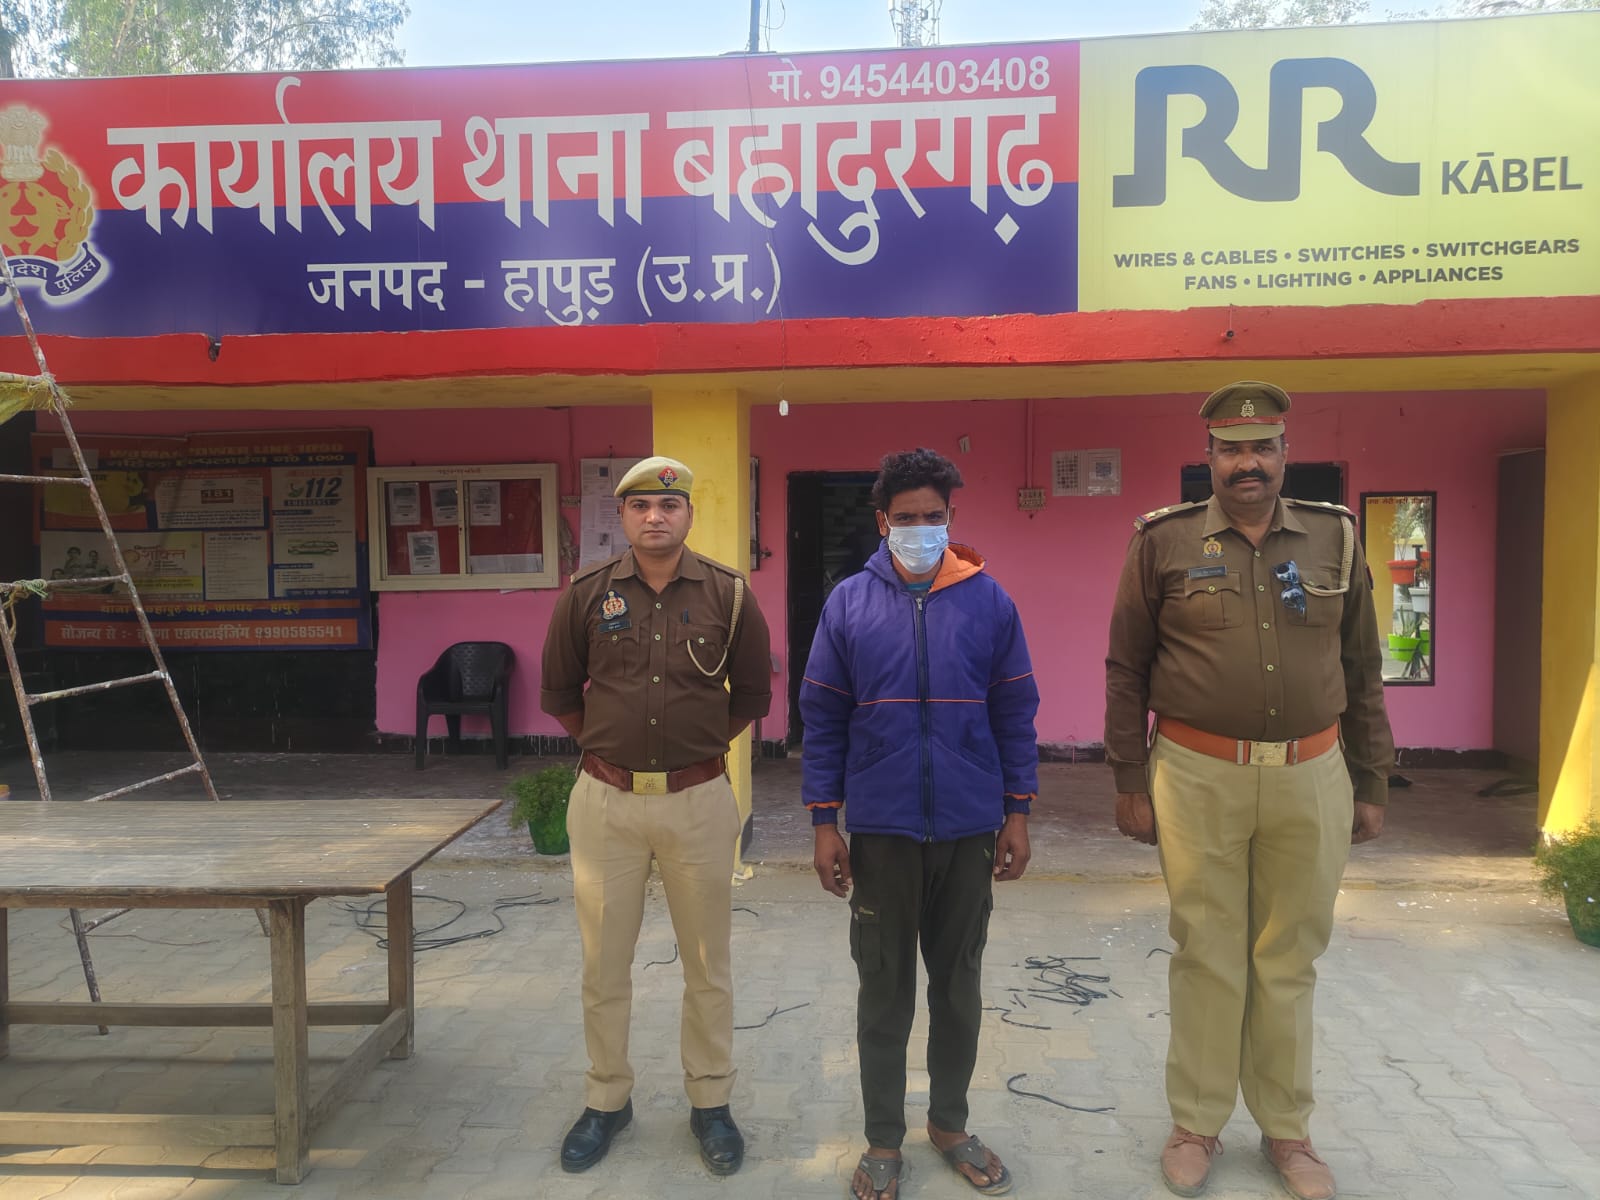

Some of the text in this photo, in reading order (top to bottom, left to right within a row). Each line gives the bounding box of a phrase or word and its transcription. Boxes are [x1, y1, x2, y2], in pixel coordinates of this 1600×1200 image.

[768, 56, 1049, 101] मो. 9454403408
[1112, 57, 1583, 207] RR KĀBEL
[107, 77, 1056, 265] कार्यालय थाना बहादुरगढ़
[1113, 238, 1580, 268] WIRES & CABLES SWITCHES SWITCHGEARS
[54, 259, 96, 294] पुलिस
[307, 261, 447, 311] जनपद
[500, 257, 616, 326] हापुड़
[637, 243, 781, 318] (उ.प्र.)
[1184, 265, 1504, 291] FANS LIGHTING APPLIANCES
[305, 477, 342, 498] 112
